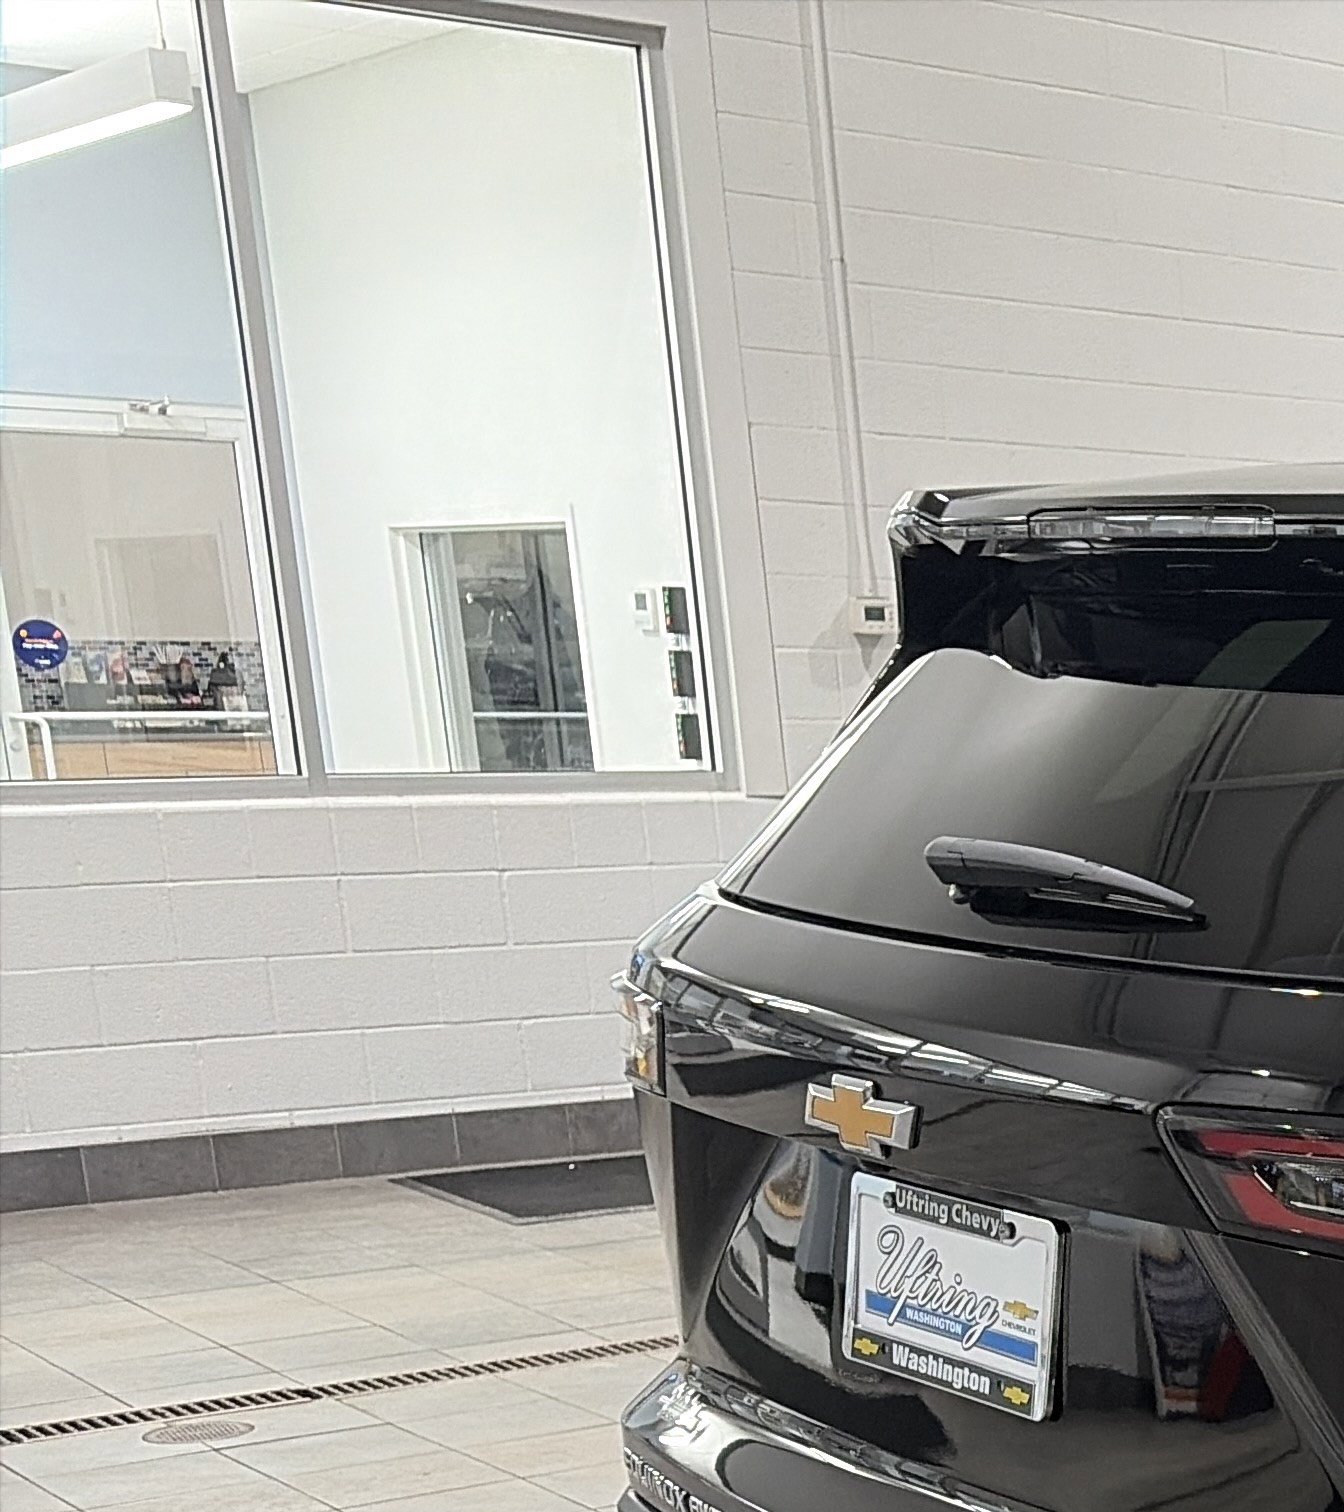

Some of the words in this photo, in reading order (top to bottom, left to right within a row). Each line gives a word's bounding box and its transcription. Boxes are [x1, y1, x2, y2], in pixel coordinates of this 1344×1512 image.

[895, 1188, 948, 1224] Uftring
[952, 1202, 1000, 1237] Chevy
[876, 1224, 999, 1348] Uftring
[905, 1309, 962, 1335] WASHINGTON
[892, 1343, 991, 1395] Washington
